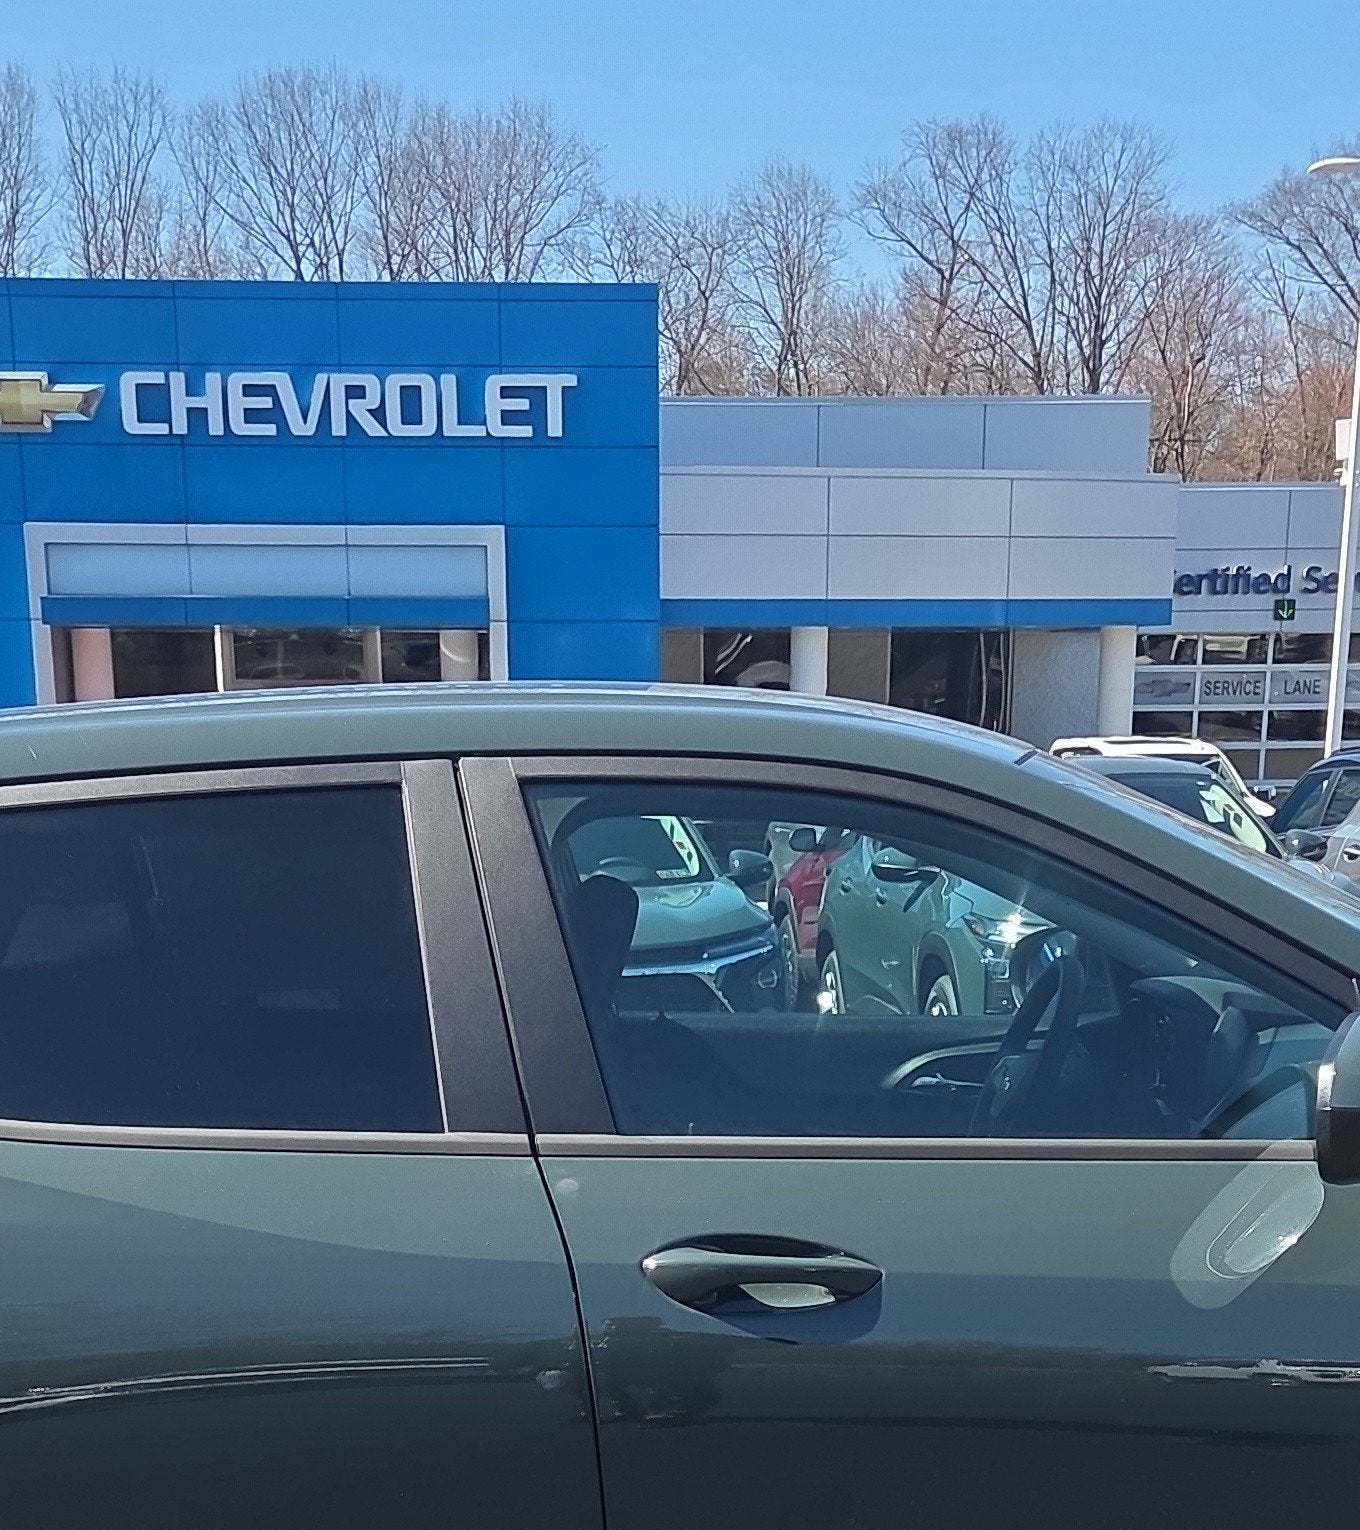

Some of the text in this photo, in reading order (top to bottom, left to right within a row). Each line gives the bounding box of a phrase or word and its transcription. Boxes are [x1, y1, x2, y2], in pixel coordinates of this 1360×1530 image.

[120, 371, 578, 438] CHEVROLET
[1173, 565, 1292, 595] ertified
[1203, 679, 1322, 697] SERVICE LANE
